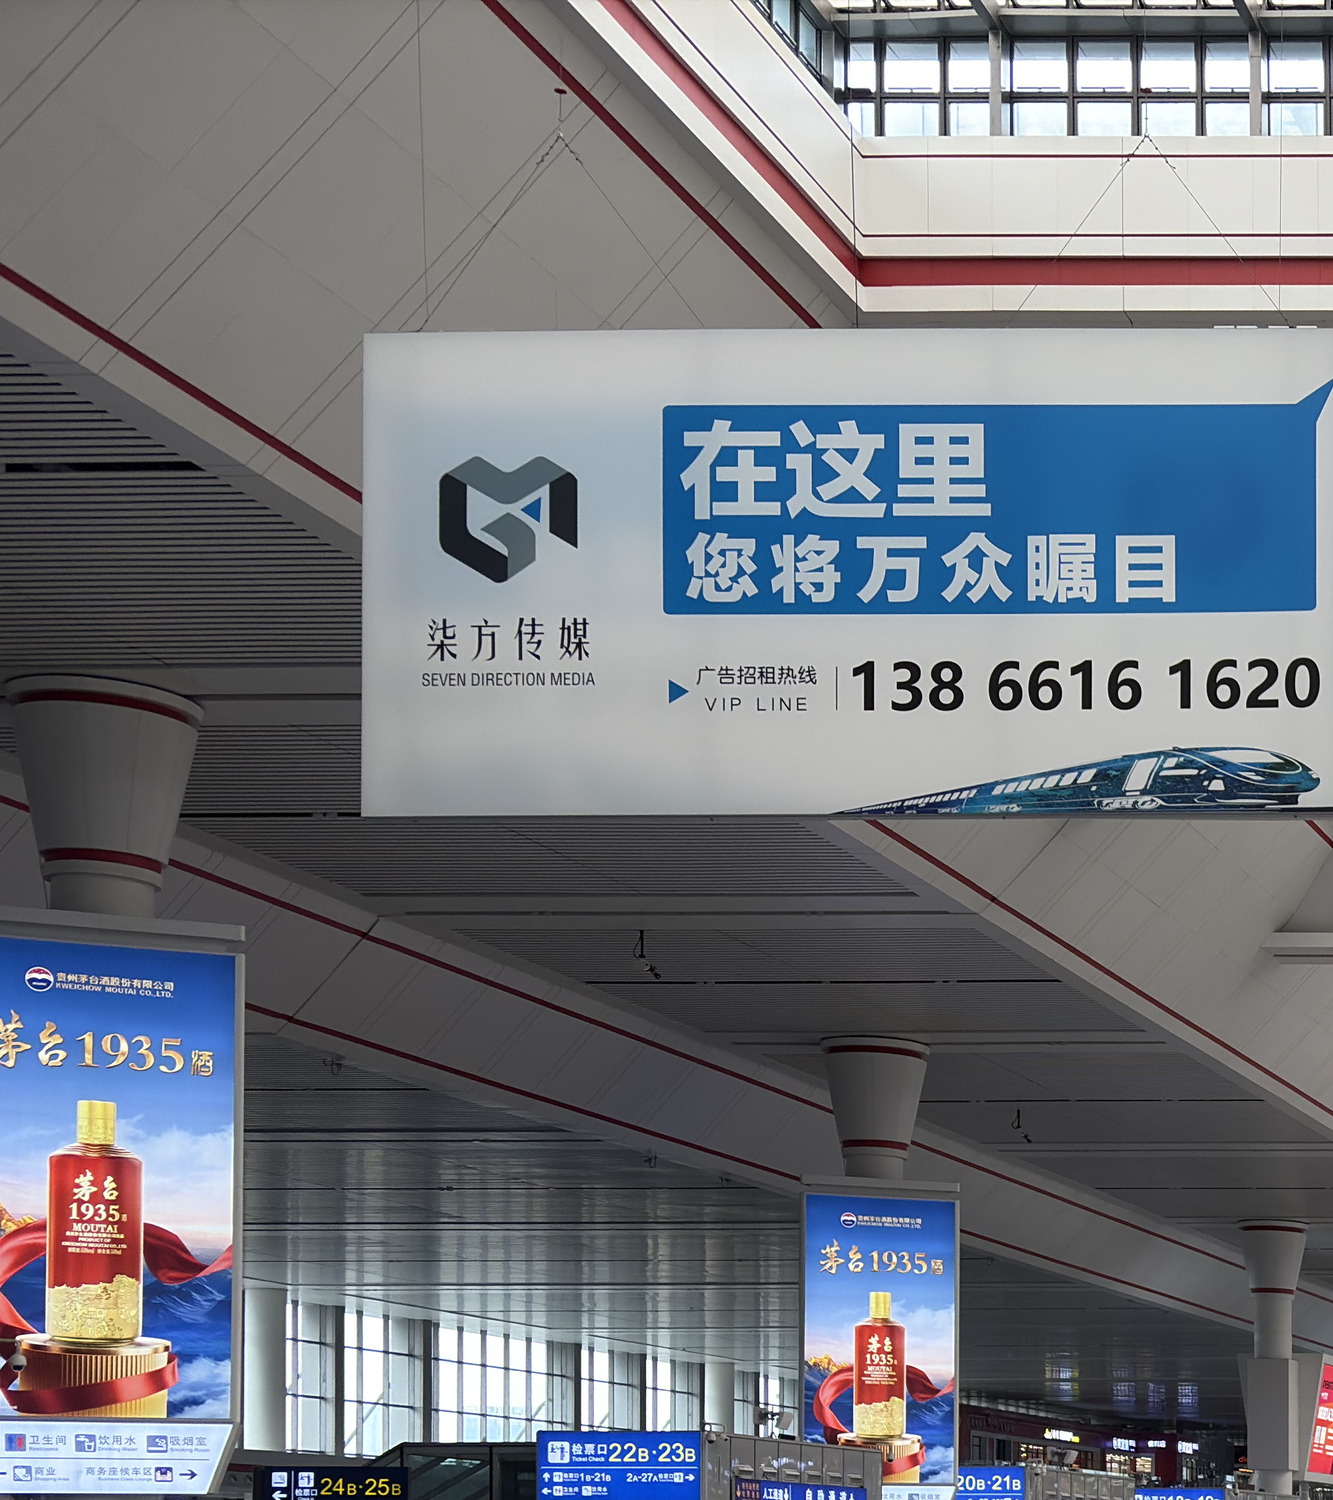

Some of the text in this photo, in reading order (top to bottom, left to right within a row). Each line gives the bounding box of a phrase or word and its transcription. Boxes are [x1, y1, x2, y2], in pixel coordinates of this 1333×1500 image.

[680, 420, 992, 520] 在这里
[687, 532, 1178, 605] 您将万众瞩目
[427, 617, 589, 661] 柒方传媒
[422, 672, 595, 687] SEVEN DIRECTION MEDIA
[696, 665, 818, 686] 广告招租热线
[851, 657, 1321, 712] 138 6616 1620
[705, 697, 808, 712] VIP LINE
[55, 982, 102, 992] KWEICHOW
[105, 986, 137, 995] MOUTAI
[56, 972, 174, 992] 贵州茅台酒股份有限公司
[72, 1223, 118, 1233] MOUTAI
[29, 1435, 207, 1447] 卫生间 饮用水 吸烟室
[572, 1443, 607, 1455] 检票口
[34, 1466, 153, 1476] 商业 商务座候车区
